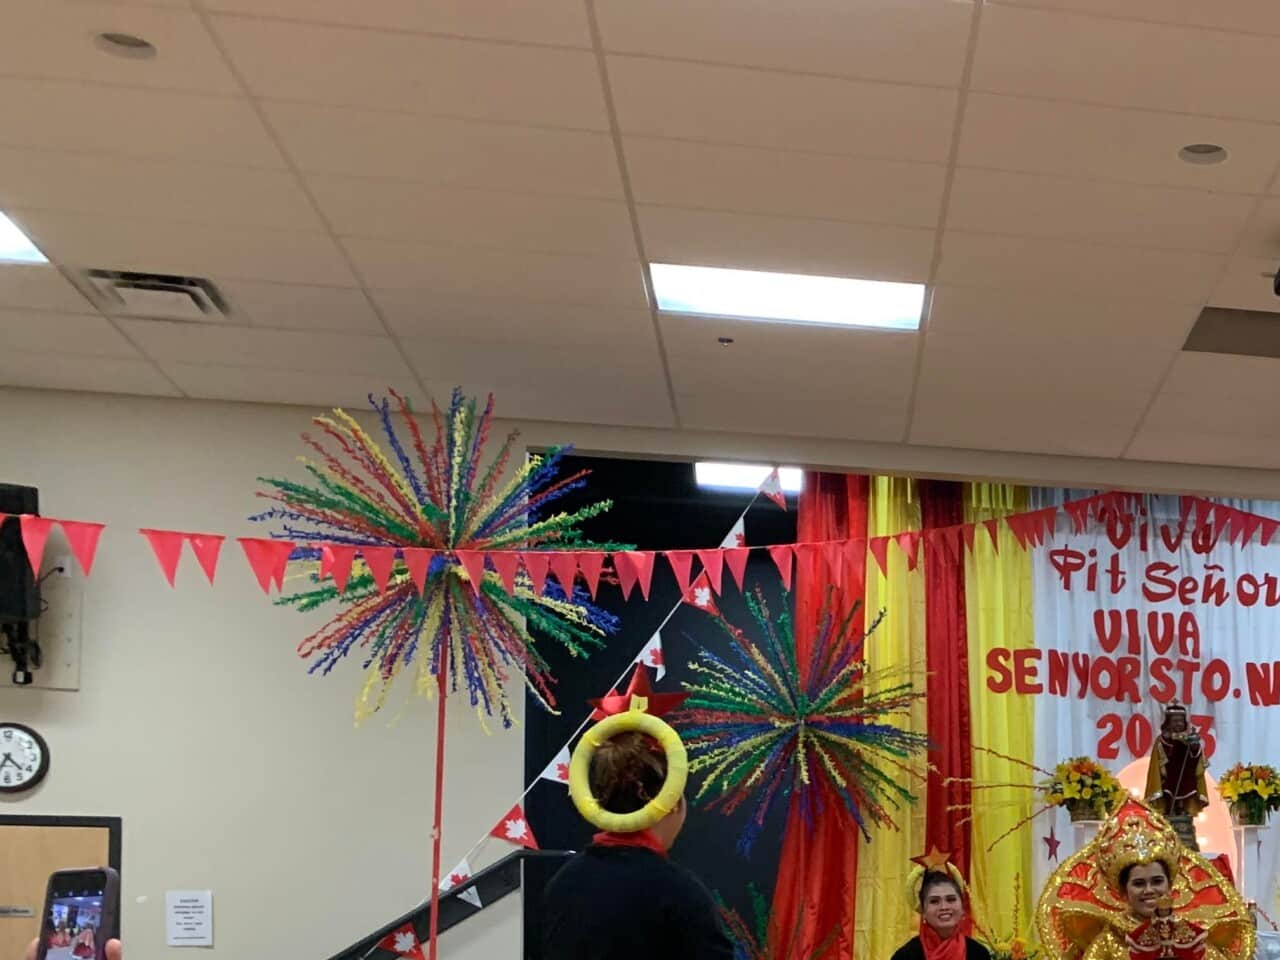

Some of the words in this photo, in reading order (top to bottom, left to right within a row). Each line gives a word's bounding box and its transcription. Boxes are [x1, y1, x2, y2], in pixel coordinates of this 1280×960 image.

[1049, 544, 1126, 595] Pit
[1094, 609, 1200, 658] VIVA
[1096, 713, 1217, 759] 203
